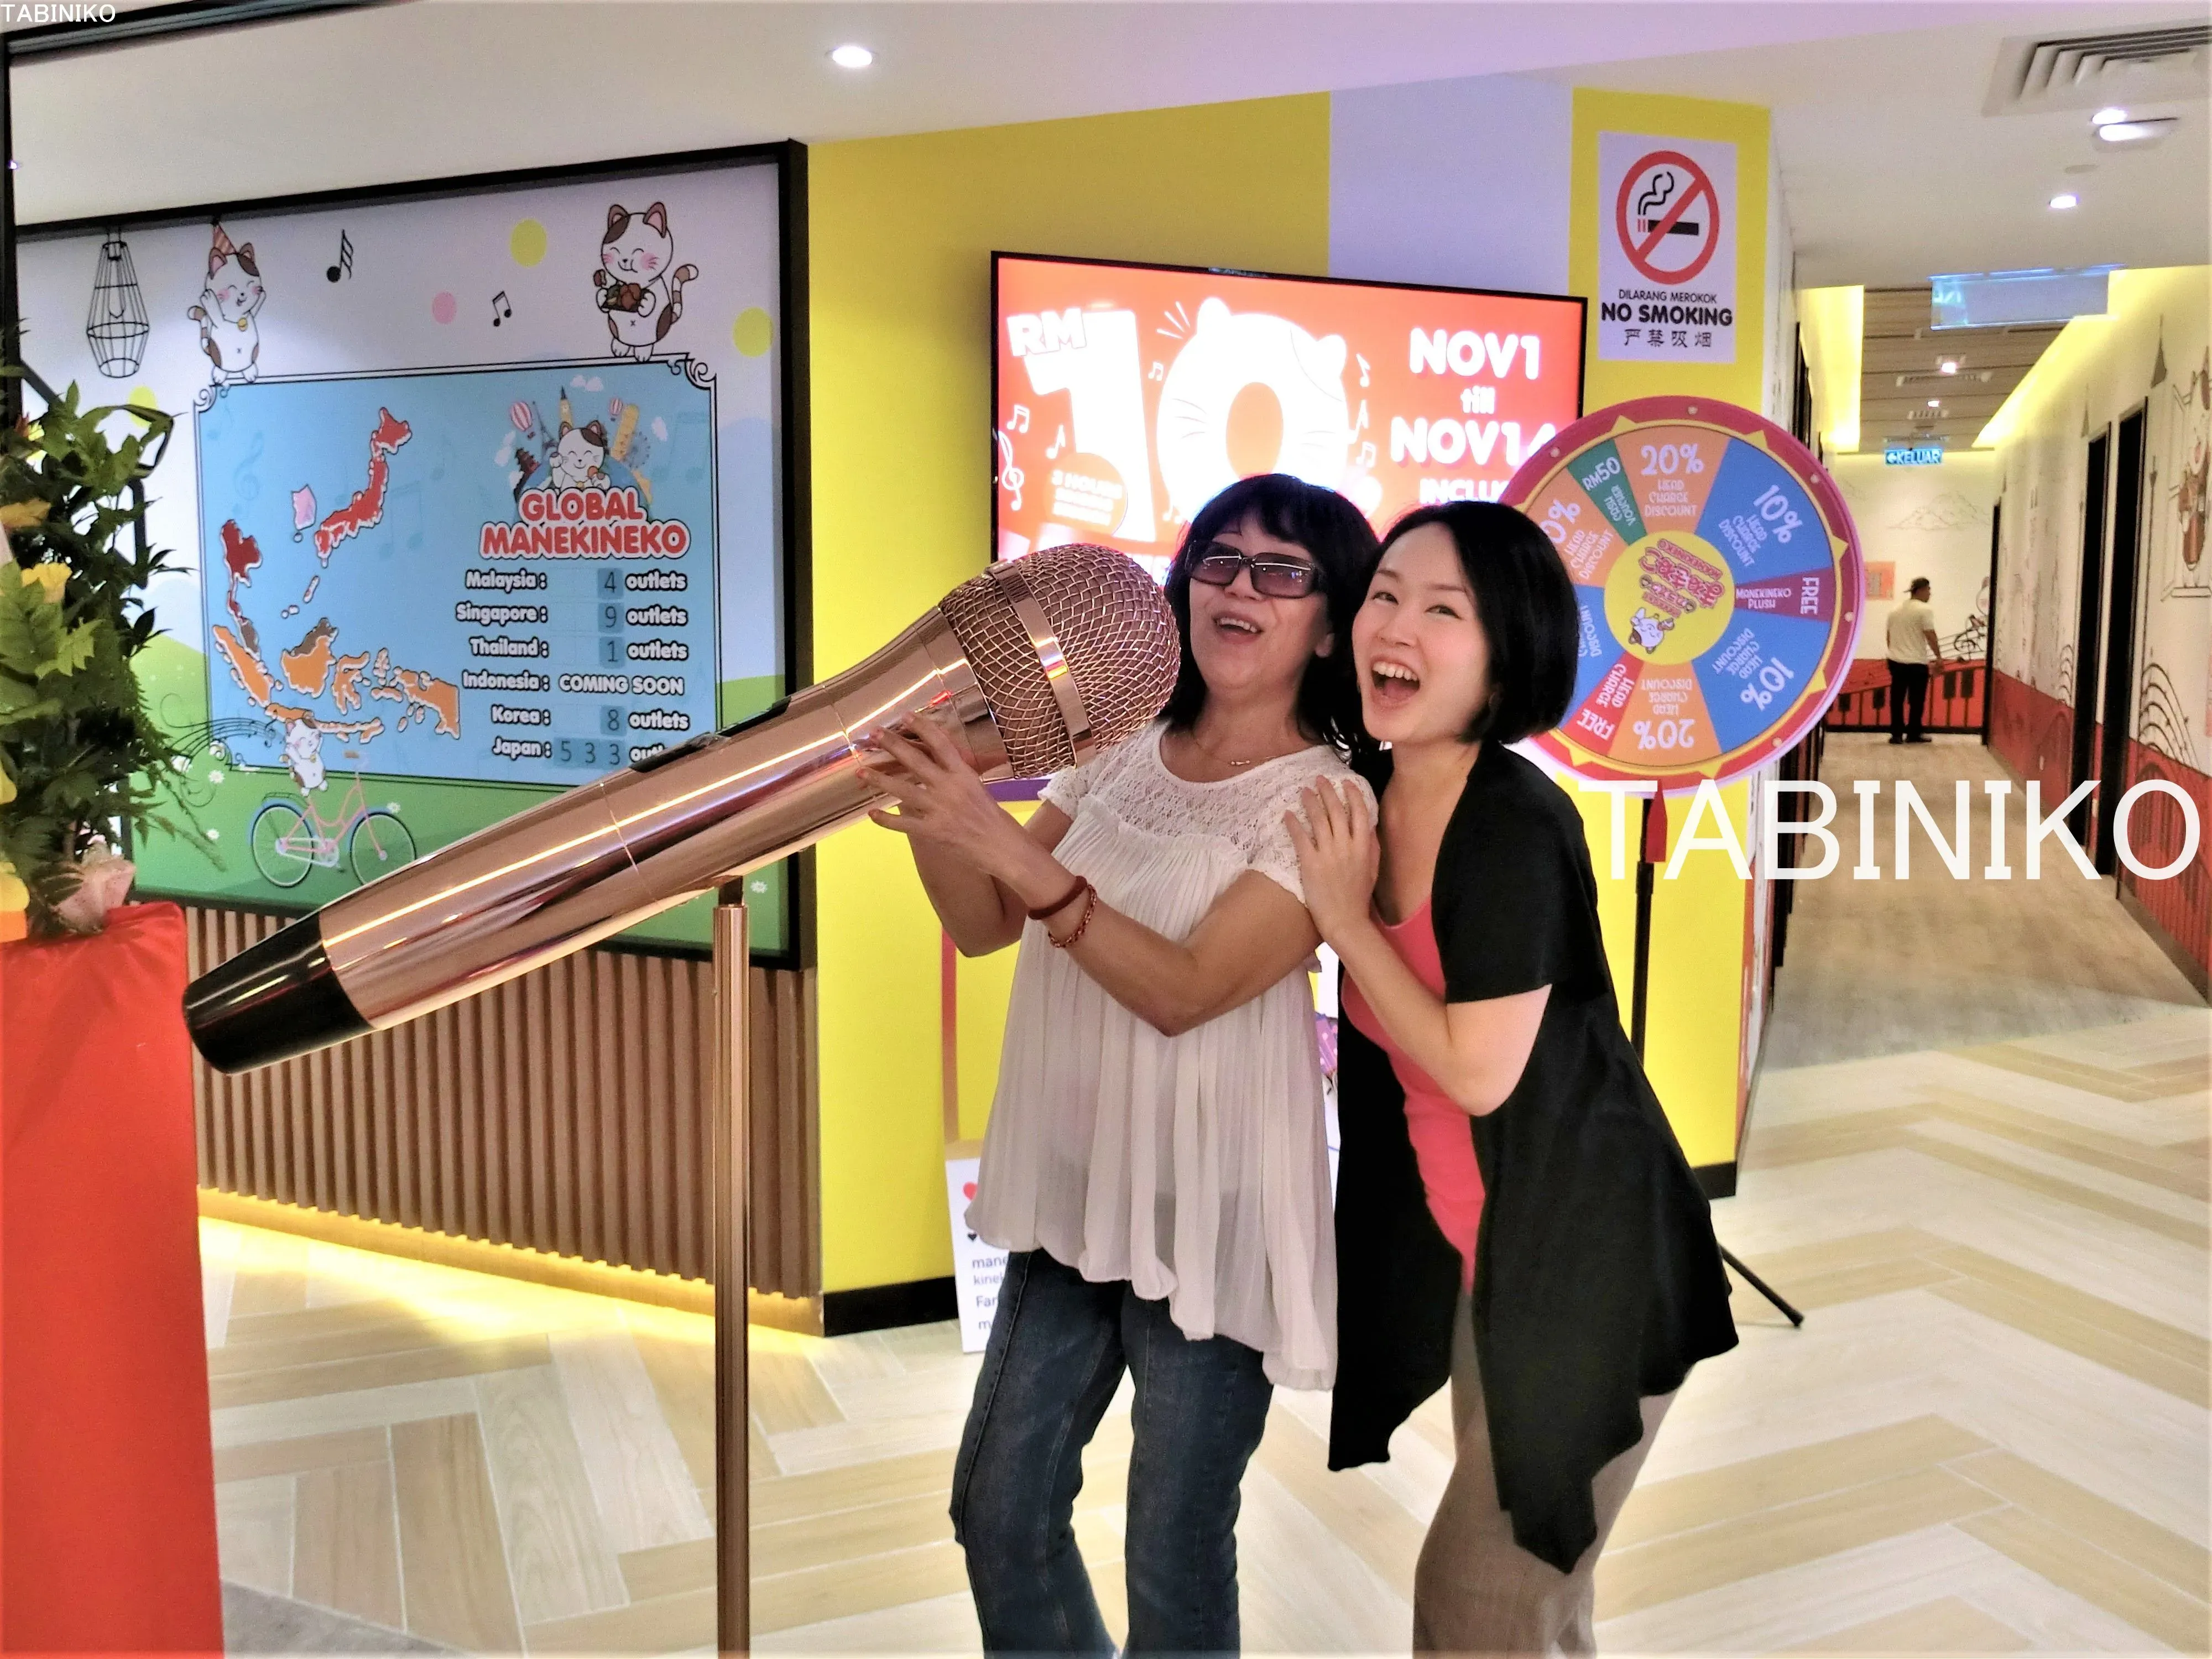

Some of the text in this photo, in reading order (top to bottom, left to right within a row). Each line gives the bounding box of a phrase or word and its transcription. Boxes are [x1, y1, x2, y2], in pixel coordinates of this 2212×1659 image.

[1619, 289, 1717, 304] DILARANG MEROKOK
[1602, 302, 1733, 326] NO SMOKING
[1006, 307, 1087, 357] RM
[1624, 328, 1712, 348] 严禁吸烟
[1460, 385, 1495, 414] till
[1641, 444, 1704, 476] 20%
[1896, 449, 1941, 465] KELUAR
[1583, 457, 1620, 492] RM50
[520, 489, 645, 523] GLOBAL
[1419, 478, 1509, 504] INCLU
[1540, 499, 1580, 544] 0%
[1644, 504, 1697, 518] DISCOUNT
[1753, 485, 1803, 544] 10%
[481, 522, 689, 556] MANEKINEKO
[1580, 529, 1613, 580] DISCOUNT
[1718, 519, 1755, 567] DISCOUNT
[604, 572, 617, 592] 4
[625, 568, 687, 591] outlets
[1747, 598, 1776, 609] PLUSH
[1799, 577, 1819, 615] FREE
[605, 606, 617, 628] 9
[626, 604, 688, 626] outlets
[607, 640, 618, 662] 1
[627, 639, 688, 661] outlets
[1712, 627, 1756, 674] DISCOUNT
[559, 675, 629, 694] COMING
[632, 676, 685, 696] SOON
[1597, 663, 1626, 707] CHARGE
[1612, 677, 1635, 709] HEAD
[1641, 678, 1692, 691] DISCOUNT
[1741, 657, 1794, 711] 10%
[609, 709, 619, 730] 8
[629, 709, 690, 731] outlets
[1576, 708, 1616, 740] FREE
[1633, 719, 1695, 749] 20%
